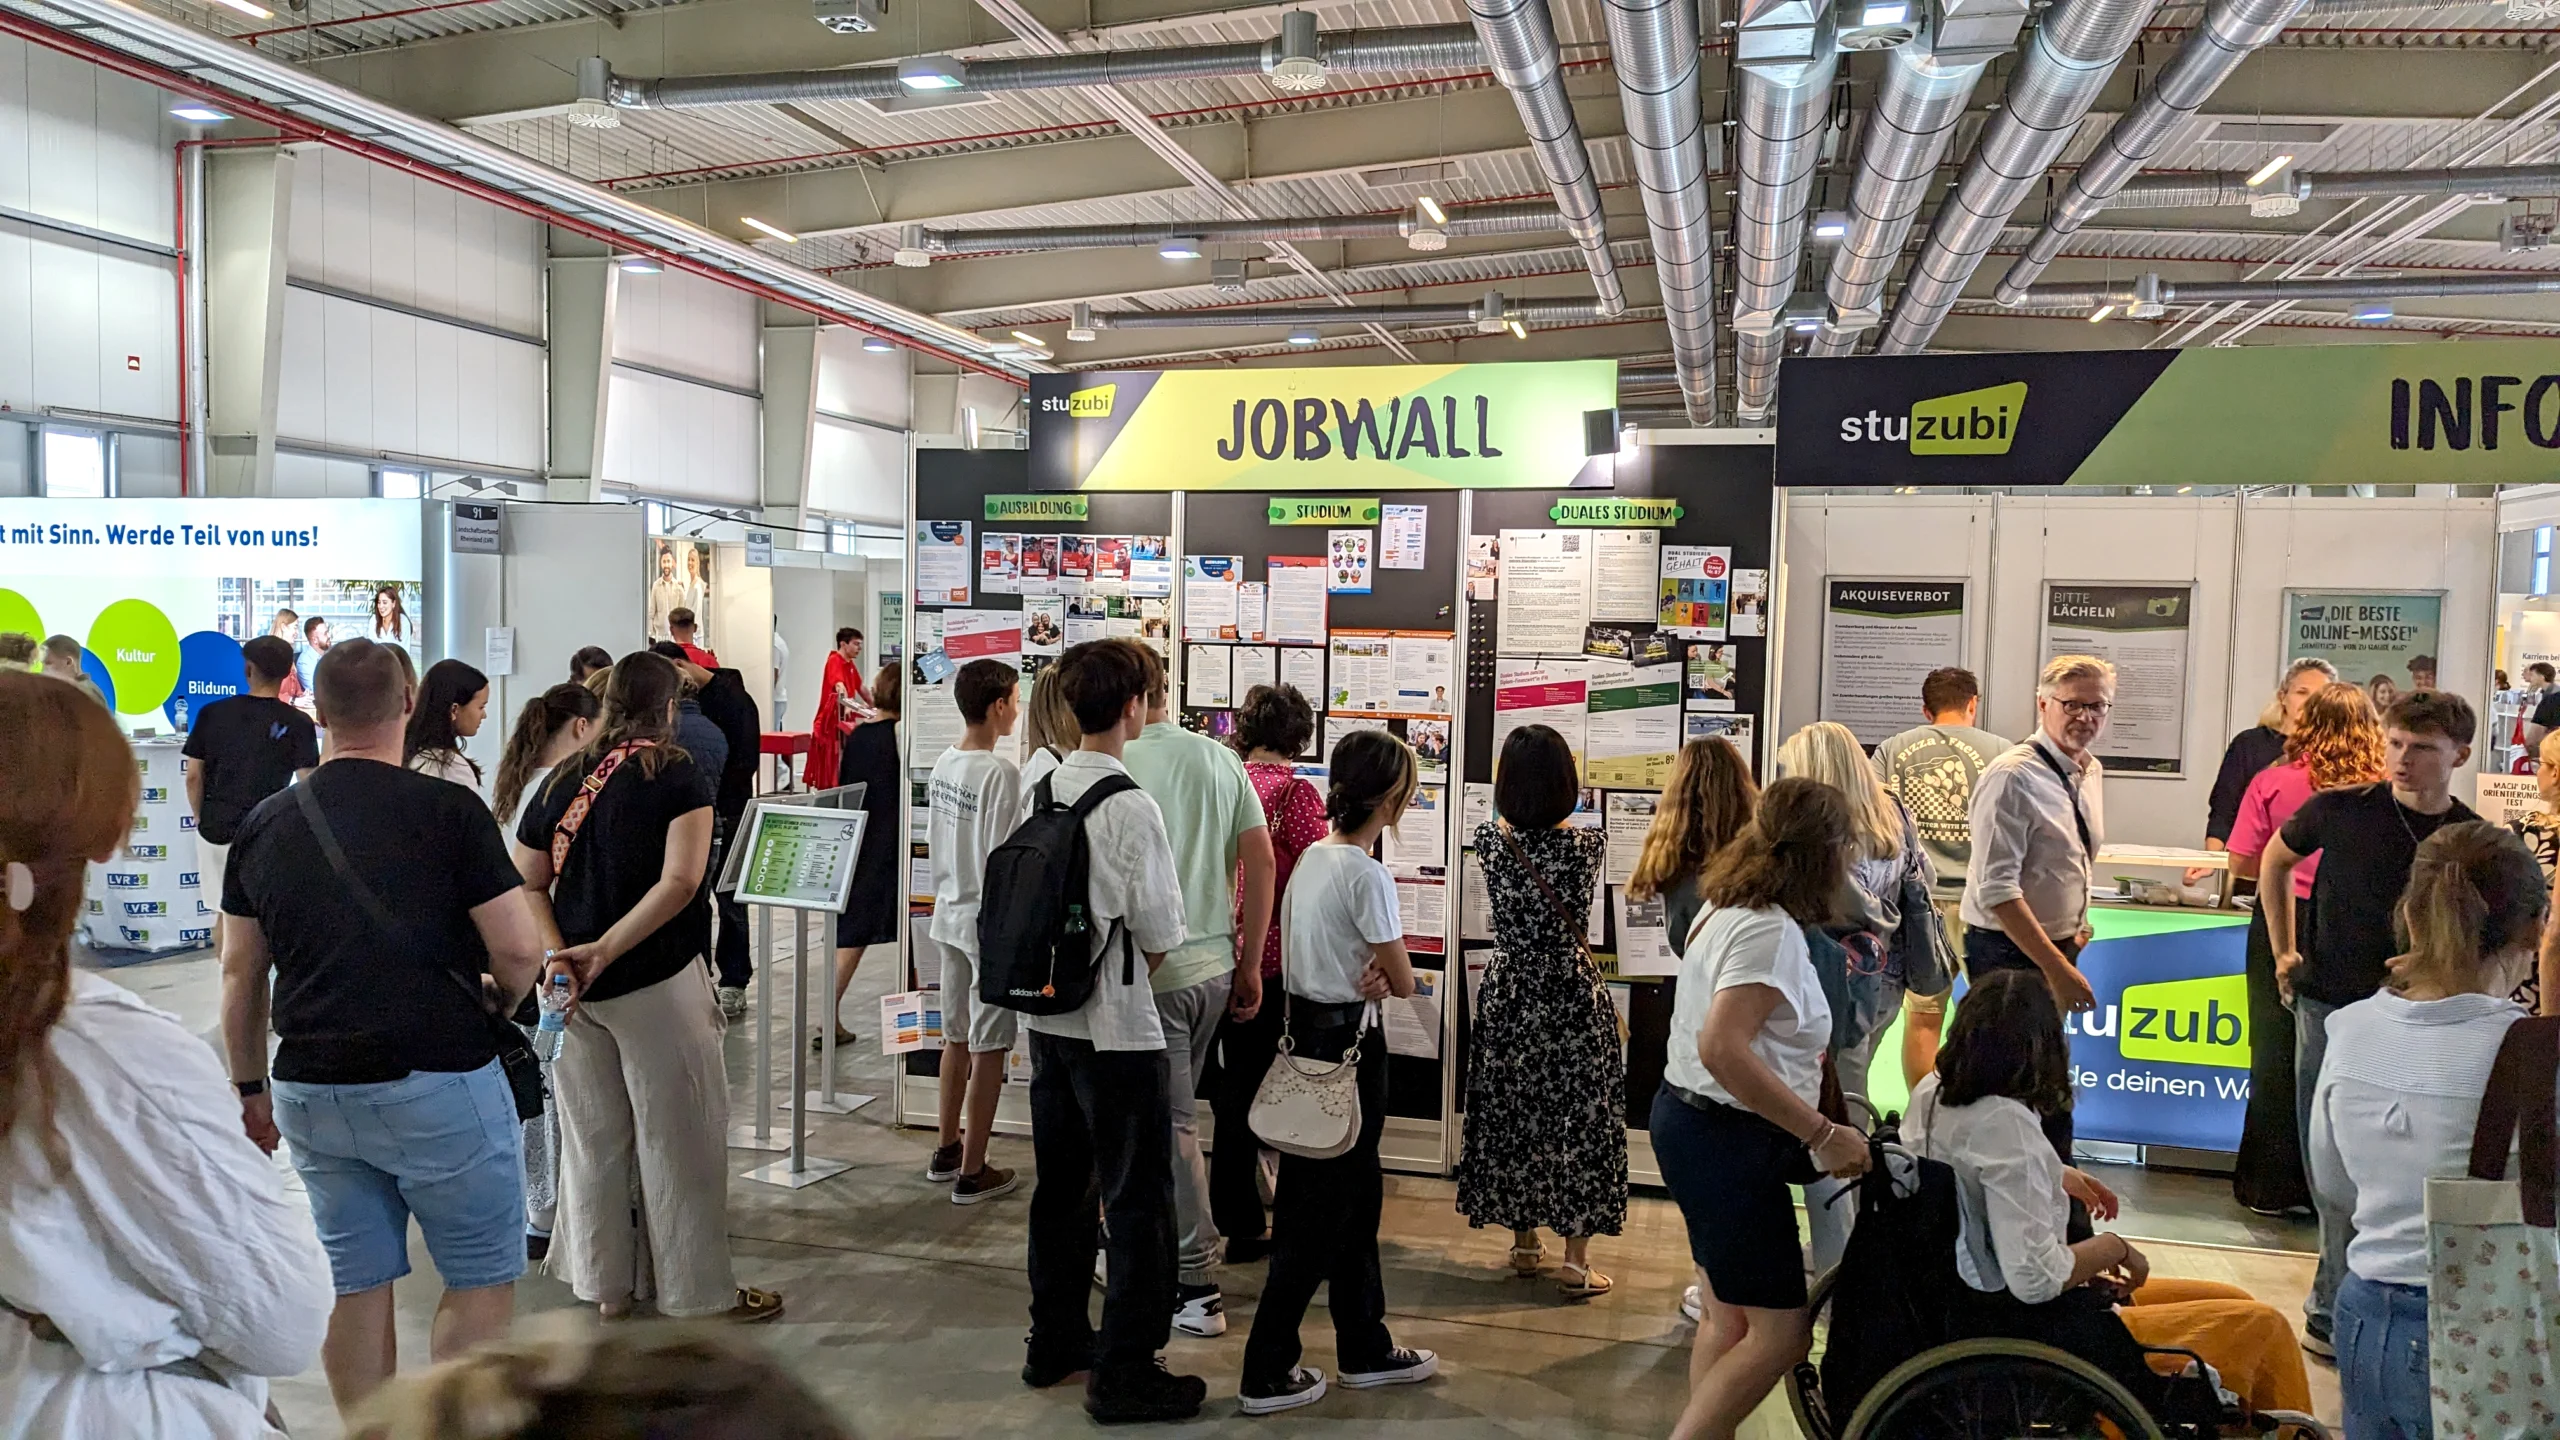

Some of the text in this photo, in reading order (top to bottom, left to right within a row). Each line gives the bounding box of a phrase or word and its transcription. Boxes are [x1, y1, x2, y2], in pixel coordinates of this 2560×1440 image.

[1040, 394, 1110, 413] stuzubi
[2390, 374, 2560, 450] INFO
[1217, 395, 1503, 462] JOBWALL
[1840, 405, 2008, 442] stuzubi
[472, 506, 482, 519] 91
[999, 501, 1073, 516] AUSBILDUNG
[1296, 504, 1352, 519] STUDIUM
[1560, 504, 1673, 521] DUALES STUDIUM
[11, 522, 44, 545] mit
[49, 523, 101, 546] Sinn.
[105, 524, 176, 546] Werde
[180, 523, 222, 546] Teil
[226, 528, 266, 547] von
[270, 525, 319, 547] uns!
[1839, 590, 1951, 603] AKQUISEVERBOT
[2053, 592, 2091, 604] BITTE
[2052, 603, 2116, 618] LÄCHELN
[2359, 606, 2402, 622] BESTE
[116, 648, 156, 663] Kultur
[2522, 652, 2550, 661] Karriere
[188, 681, 237, 697] Bildung
[1665, 754, 1675, 765] 89
[2520, 783, 2538, 791] DEN
[2505, 798, 2524, 807] TEST
[1917, 821, 1939, 829] ETTER
[108, 874, 132, 885] LVR
[126, 903, 150, 914] LVR
[181, 930, 205, 941] LVR
[1009, 988, 1034, 997] adidas
[2107, 1068, 2205, 1097] deinen
